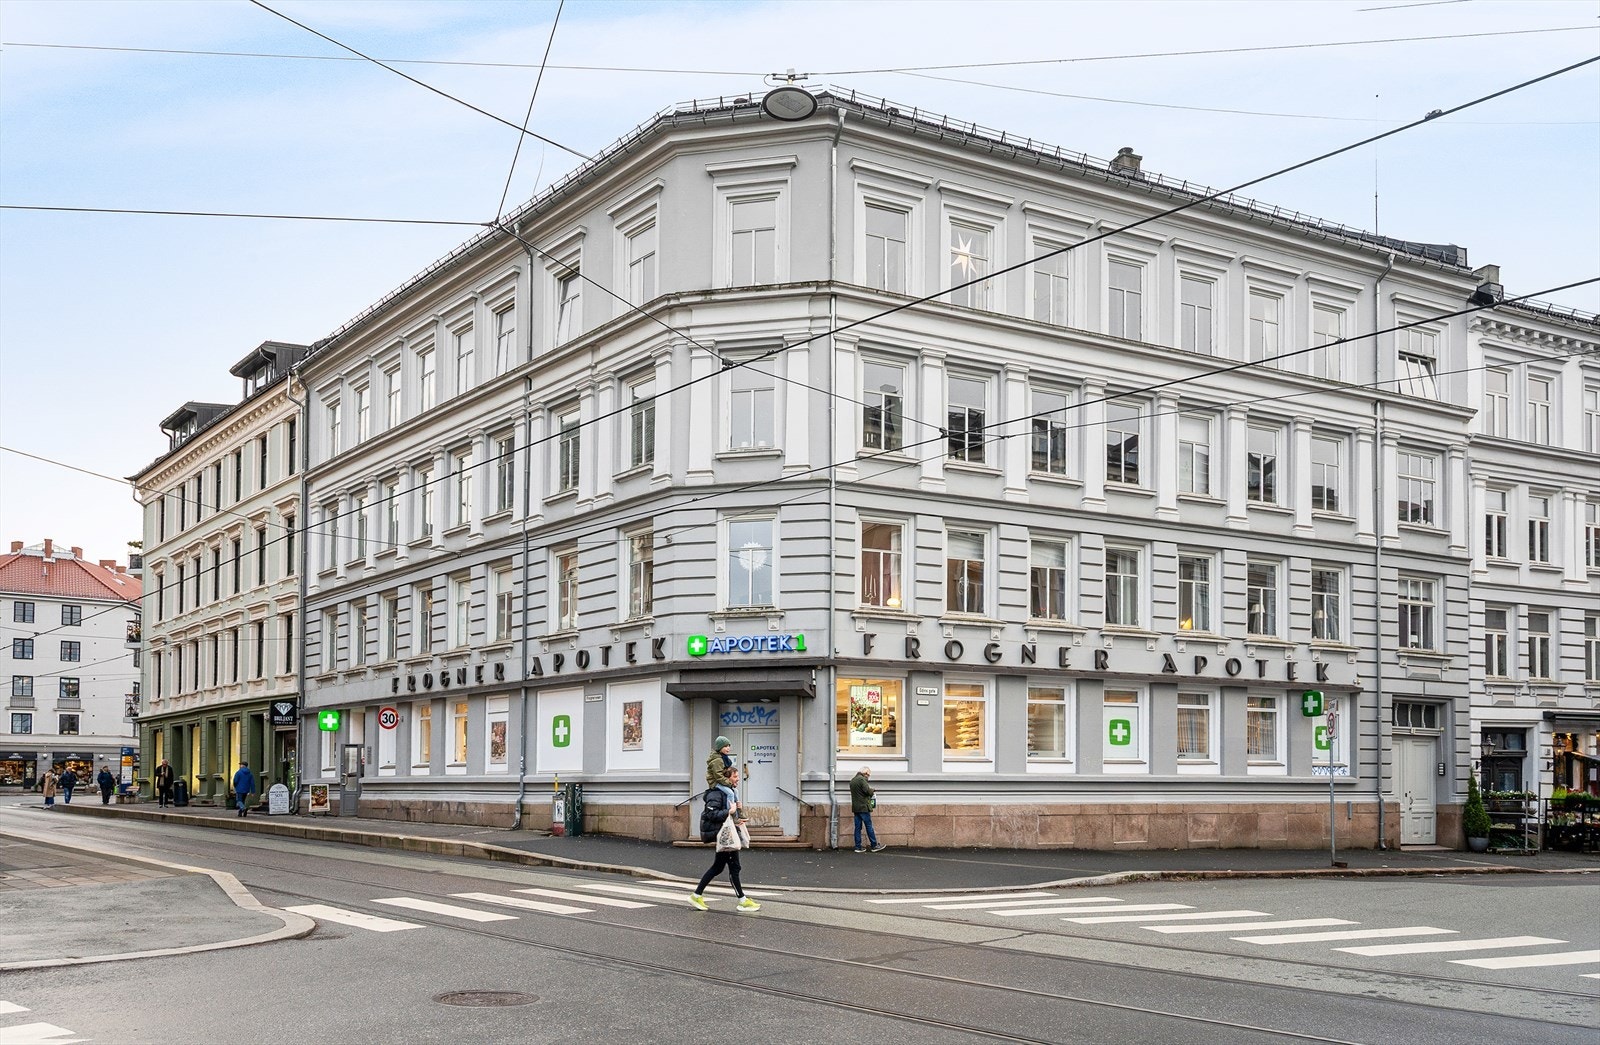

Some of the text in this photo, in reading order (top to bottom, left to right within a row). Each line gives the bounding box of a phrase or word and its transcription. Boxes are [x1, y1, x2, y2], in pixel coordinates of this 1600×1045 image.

[710, 633, 807, 655] APOTEK 1
[863, 632, 1330, 682] FROGNER APOTEK
[391, 637, 666, 694] FROGNER APOTEK
[382, 713, 395, 724] 30
